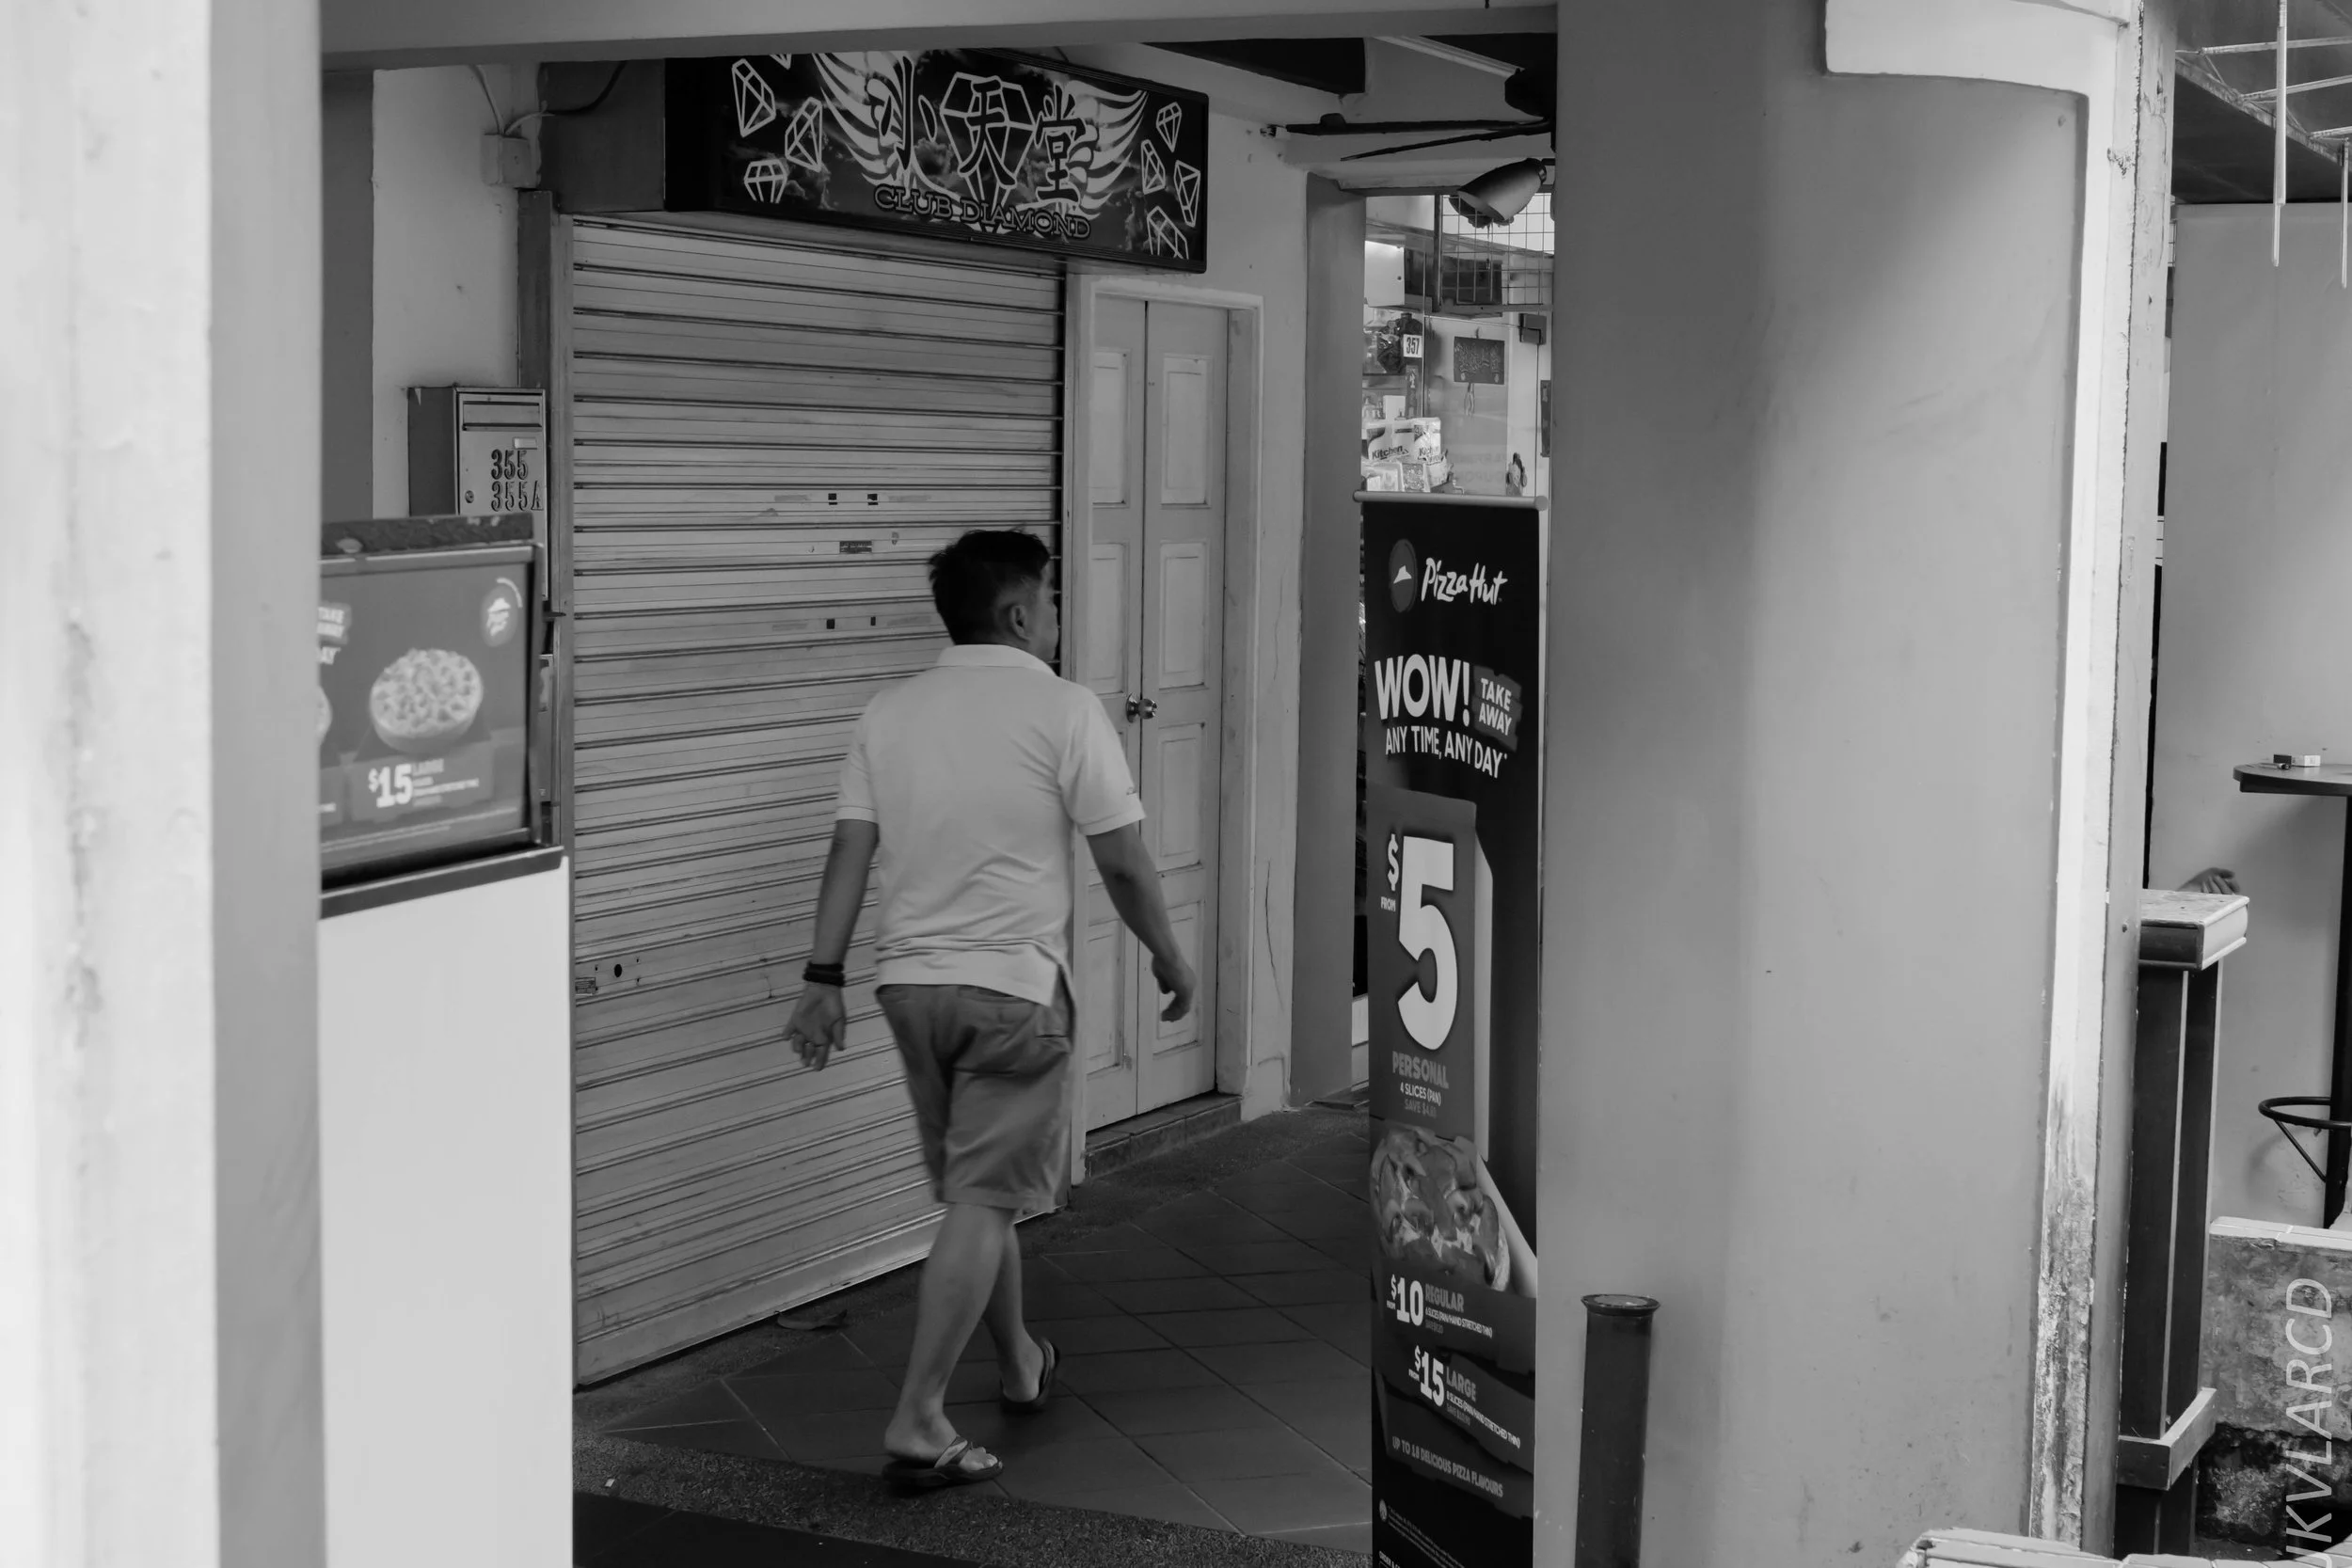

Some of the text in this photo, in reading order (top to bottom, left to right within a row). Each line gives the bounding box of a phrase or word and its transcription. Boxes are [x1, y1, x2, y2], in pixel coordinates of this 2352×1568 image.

[867, 55, 1086, 204] 小天堂
[874, 183, 1091, 239] CLUB DIAMOND
[1406, 337, 1420, 355] 357
[490, 449, 529, 480] 355
[1372, 445, 1404, 459] Kitchen
[490, 481, 544, 512] 355A
[1421, 557, 1508, 605] Pizza Hut
[1375, 654, 1470, 727] WOW!
[1480, 677, 1512, 712] TAKE
[1478, 703, 1513, 736] AWAY
[1385, 725, 1407, 755] ANY
[1410, 725, 1442, 760] TIME,
[1444, 731, 1473, 765] ANY
[368, 763, 414, 808] $15
[1380, 896, 1396, 911] FROM
[1392, 1051, 1450, 1089] PERSONAL
[1405, 1083, 1427, 1100] SLICES
[1427, 1087, 1442, 1106] (PAN)
[1391, 1274, 1424, 1326] $10
[1425, 1283, 1464, 1313] REGULAR
[1414, 1345, 1445, 1407] $15
[1446, 1366, 1477, 1403] LARGE
[1392, 1435, 1504, 1498] UP TO 18 DELICIOUS PIZZA FLAVOURS
